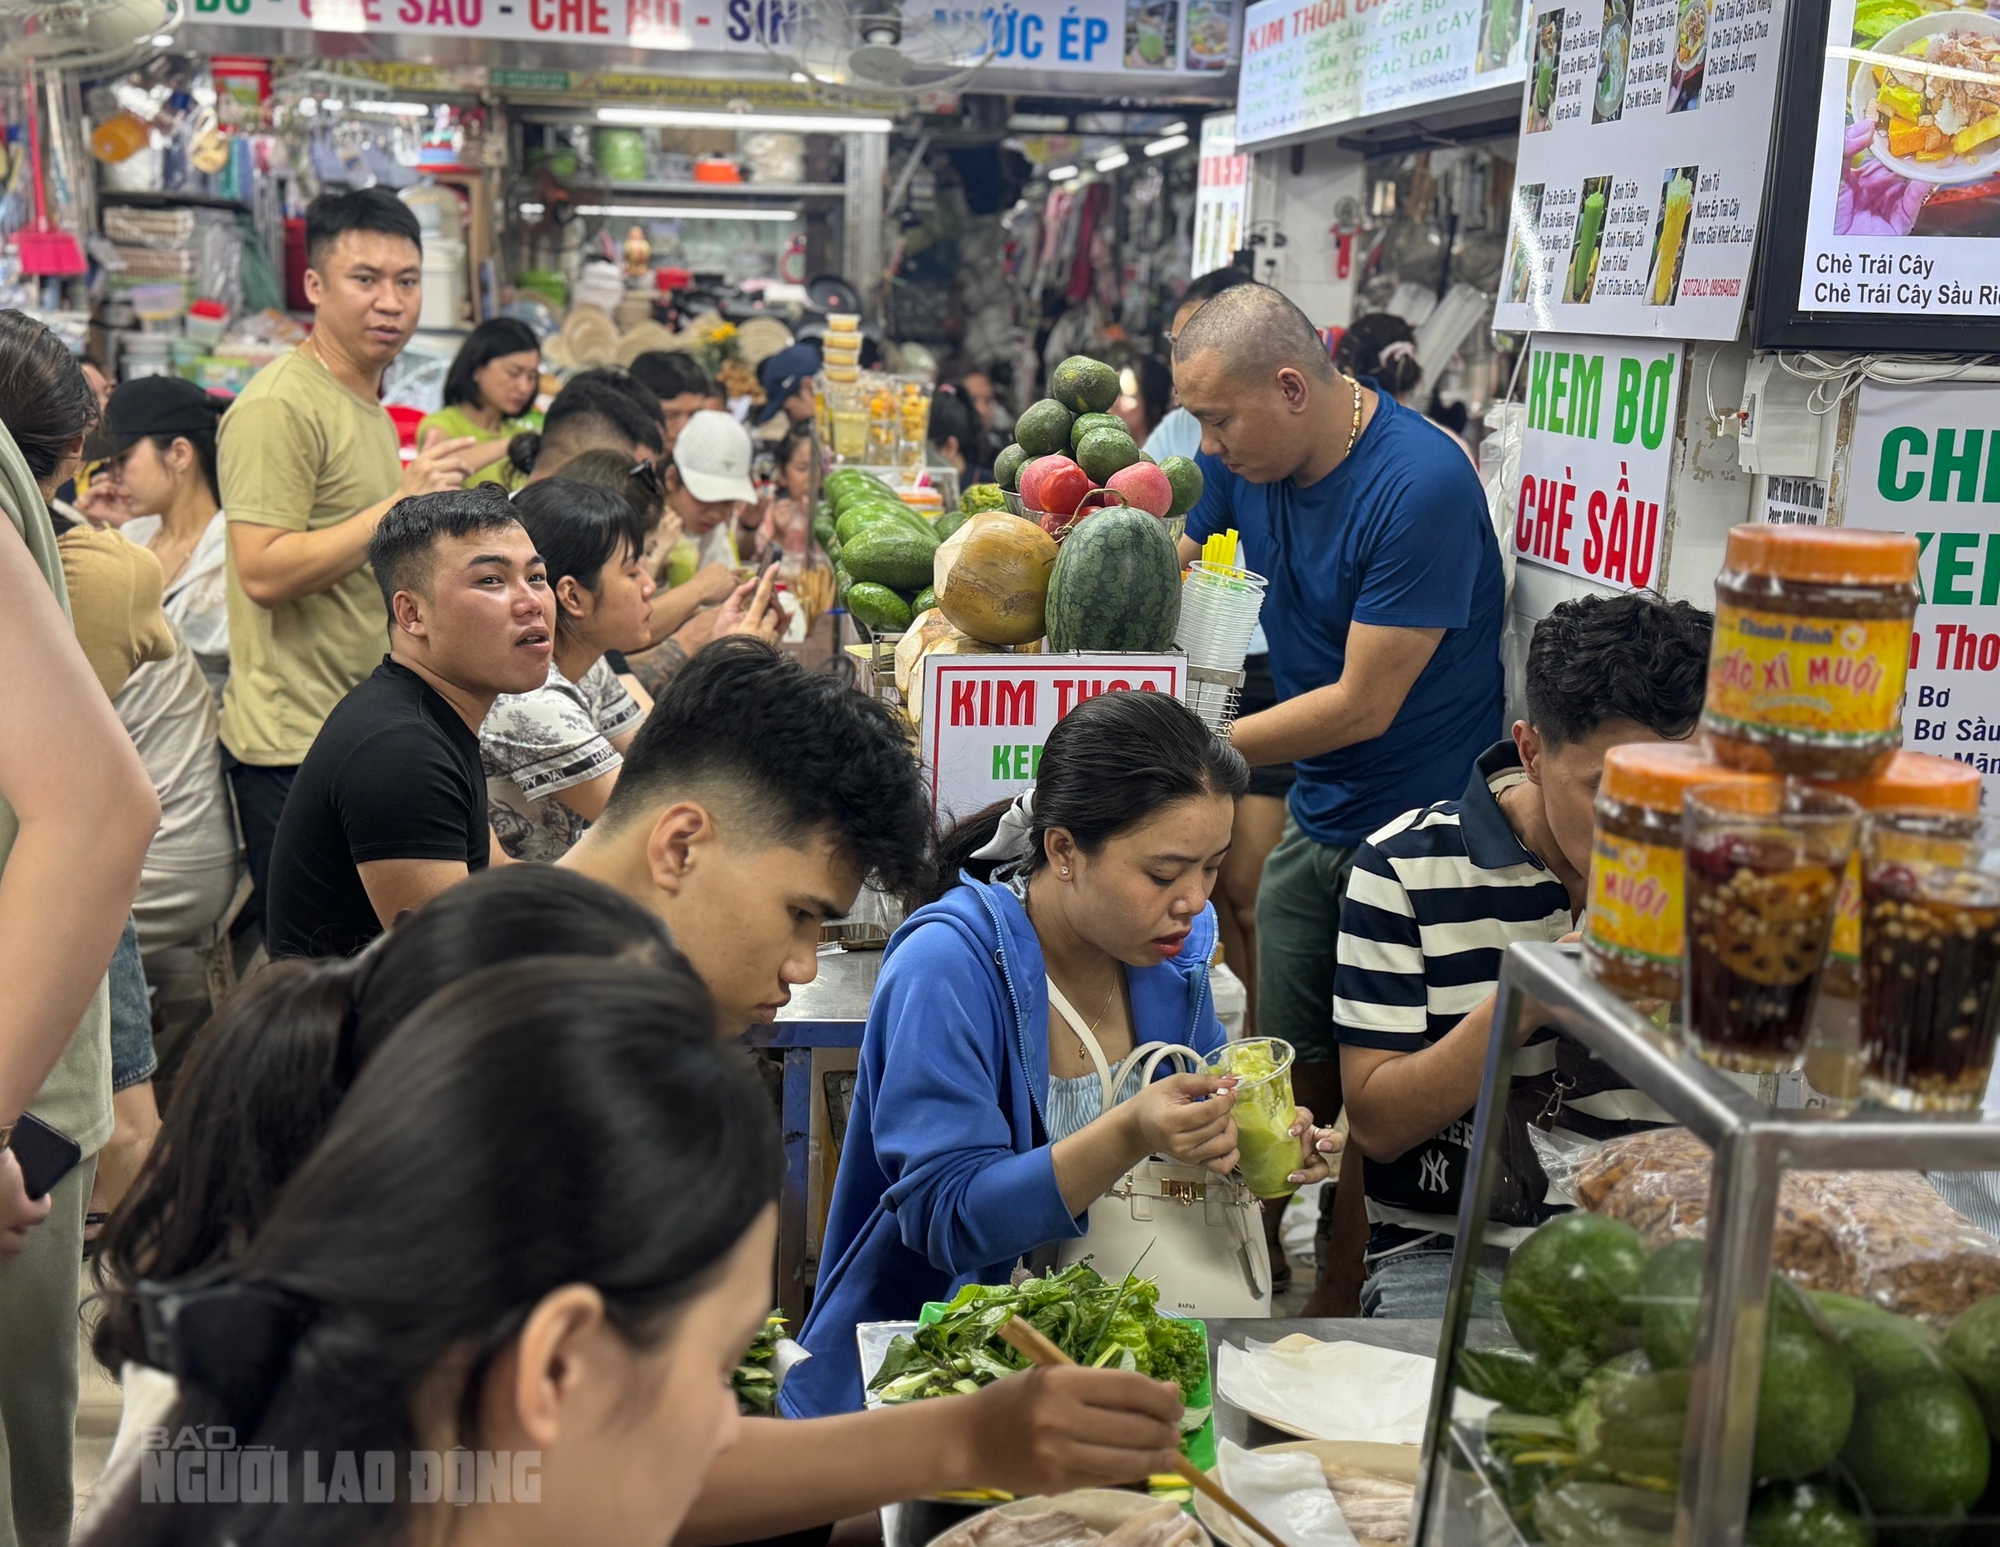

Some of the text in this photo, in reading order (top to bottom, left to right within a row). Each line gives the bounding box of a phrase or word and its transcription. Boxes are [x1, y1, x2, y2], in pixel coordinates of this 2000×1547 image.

[1565, 13, 1575, 29] Kem
[1715, 3, 1725, 23] Chè
[1248, 0, 1346, 53] KIM THOA
[1634, 18, 1643, 36] Chè
[1711, 20, 1769, 49] Chè Trái Cây Sữa Chua
[1058, 12, 1108, 62] ÉP
[1563, 36, 1573, 52] Kem
[1631, 42, 1641, 60] Chè
[1561, 59, 1571, 75] Kem
[1628, 67, 1638, 85] Chè
[1708, 57, 1719, 76] Chè
[1558, 81, 1568, 98] Kem
[1705, 83, 1715, 103] Chè
[1725, 80, 1735, 100] Sen
[1625, 91, 1635, 109] Chè
[1555, 105, 1565, 121] Kem
[1613, 183, 1624, 200] Sinh
[1700, 174, 1712, 192] Sinh
[1610, 207, 1620, 224] Sinh
[1695, 200, 1711, 219] Nước
[1605, 231, 1616, 248] Sinh
[1691, 226, 1706, 245] Nước
[1601, 255, 1611, 272] Sinh
[1816, 253, 1934, 280] Chè Trái Cây
[1815, 282, 1851, 303] Chè
[1857, 283, 1891, 304] Trái
[1897, 283, 1933, 309] Cây
[1938, 280, 1973, 305] Sầu
[1528, 351, 1675, 450] KEM BƠ
[1516, 461, 1659, 589] CHÈ SẦU
[1808, 653, 1883, 696] MUỘI
[950, 680, 1158, 727] KIM TH
[1918, 686, 1951, 708] Bơ
[1914, 716, 2000, 742] Bơ Sầu
[541, 768, 565, 783] DAY
[1418, 1149, 1450, 1194] NY
